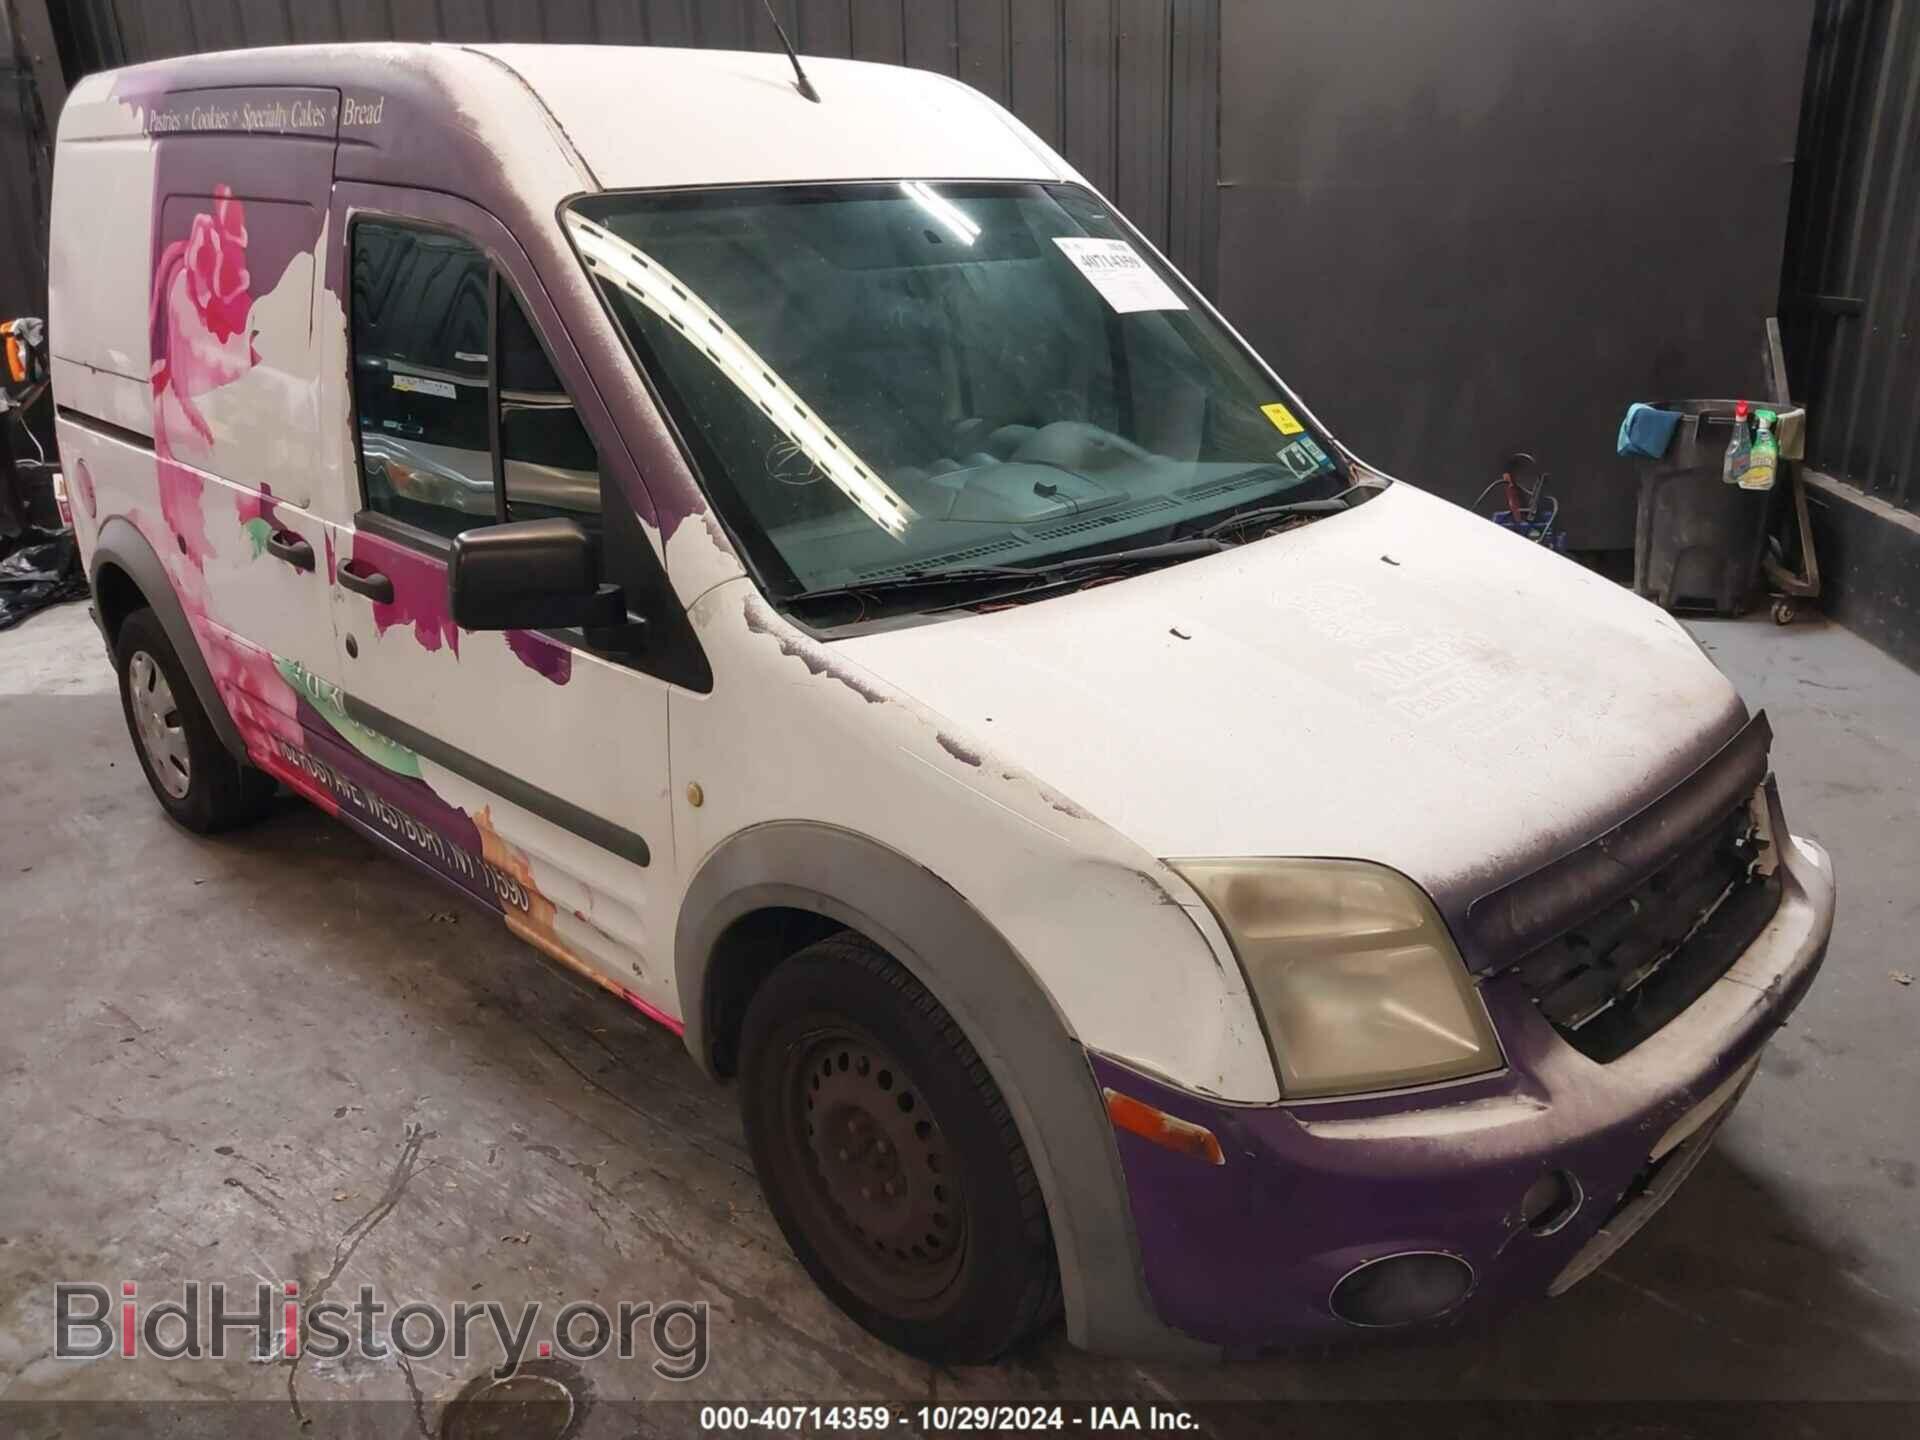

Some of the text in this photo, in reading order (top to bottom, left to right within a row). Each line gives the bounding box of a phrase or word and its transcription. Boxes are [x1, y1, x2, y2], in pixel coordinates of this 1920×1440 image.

[192, 106, 228, 130] Cookies
[242, 103, 287, 134] Specialty
[291, 100, 325, 128] Cakes
[344, 96, 384, 126] Bread
[480, 862, 529, 912] 11590
